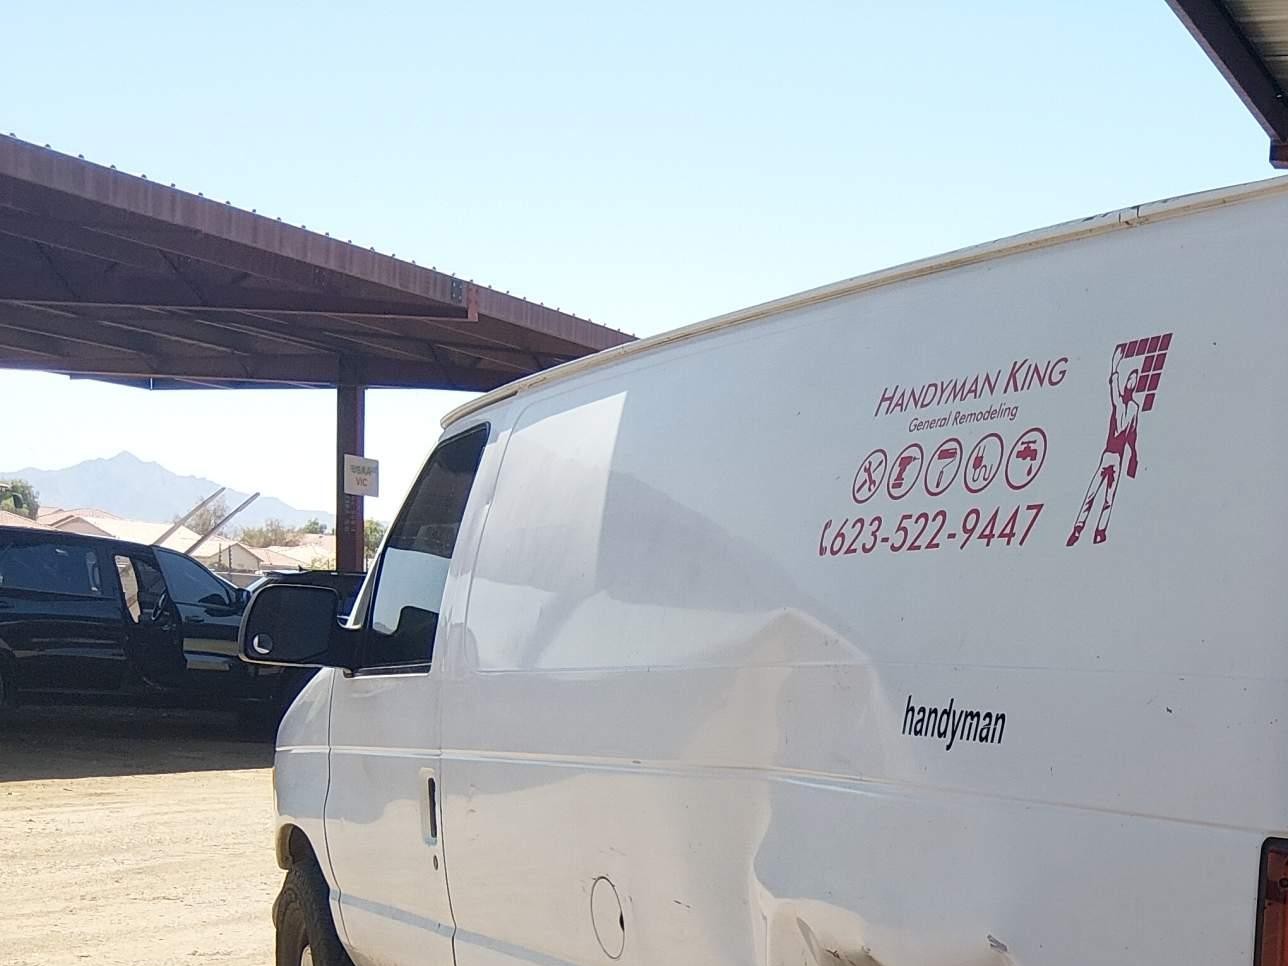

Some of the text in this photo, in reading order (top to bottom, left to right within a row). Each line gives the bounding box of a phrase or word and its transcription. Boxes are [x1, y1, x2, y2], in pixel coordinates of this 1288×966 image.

[874, 357, 1069, 417] HANDYMAN KING
[908, 403, 1019, 433] General Remodeling
[902, 694, 1006, 751] handyman
